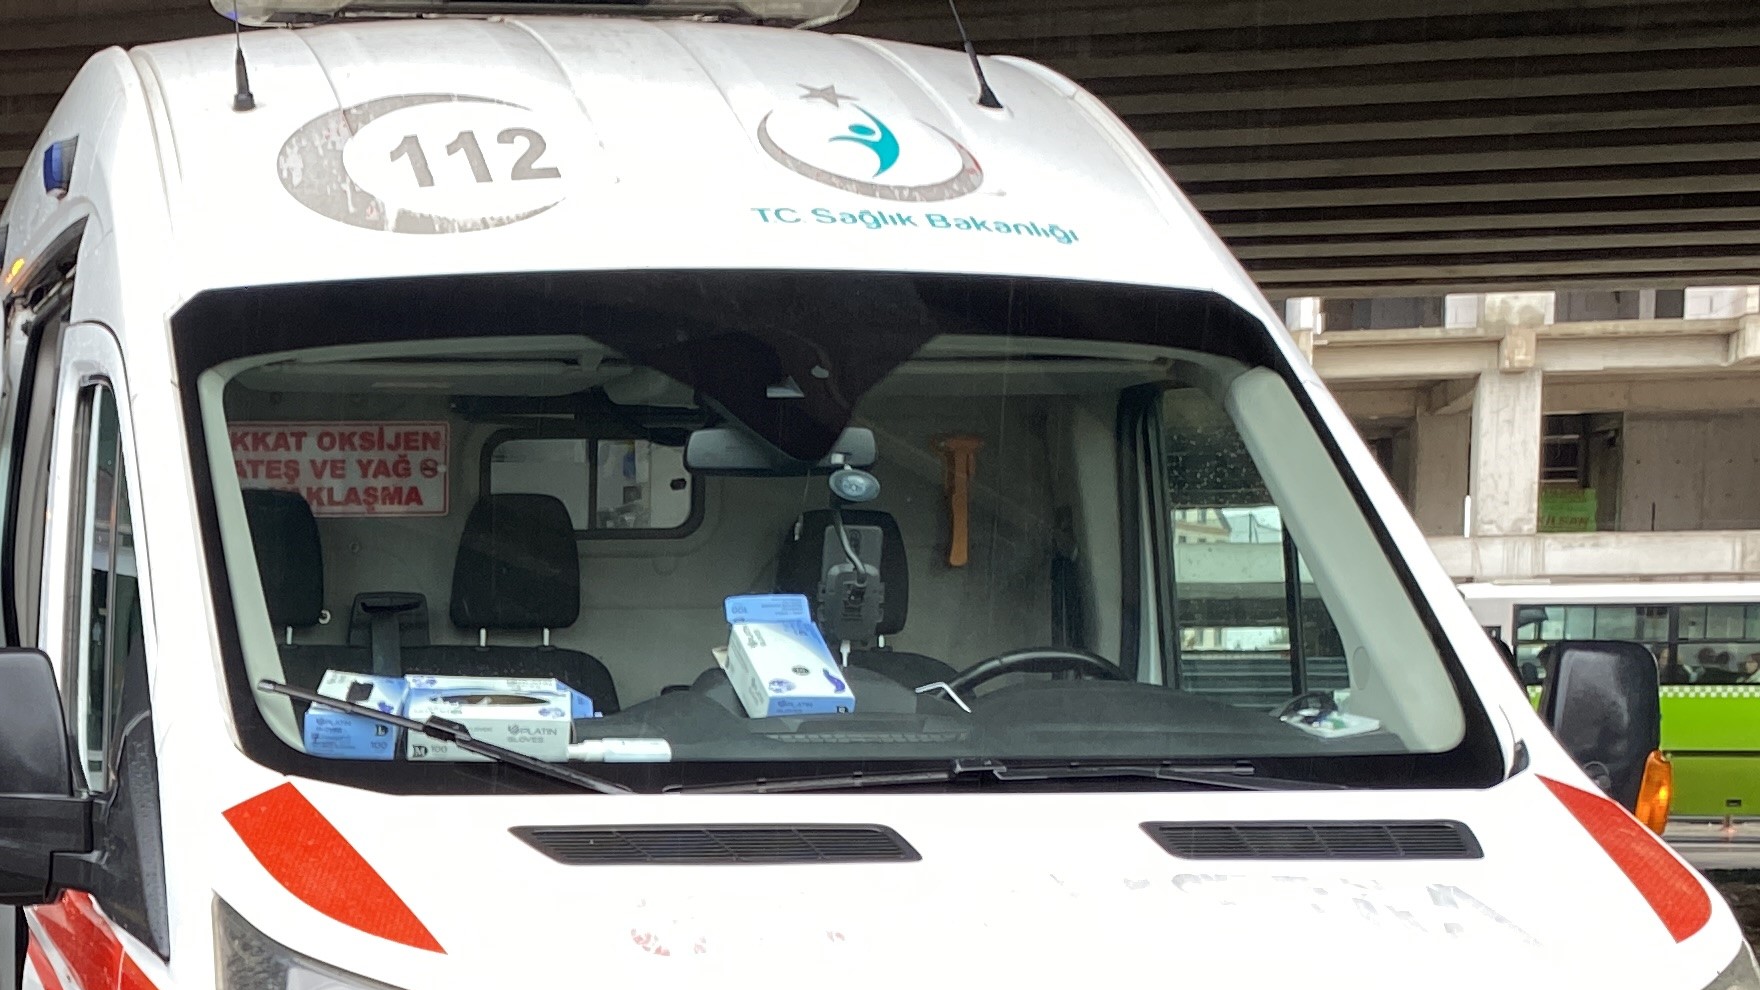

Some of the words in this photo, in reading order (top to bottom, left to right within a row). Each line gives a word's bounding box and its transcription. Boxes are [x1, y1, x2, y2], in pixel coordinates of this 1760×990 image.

[389, 126, 562, 188] 112
[810, 207, 920, 230] Sağlık
[924, 212, 1080, 245] Bakanlığı
[316, 426, 441, 451] OKSİJEN
[308, 458, 347, 479] VE
[355, 453, 412, 479] YAĞ
[293, 486, 424, 513] KLAŞMA
